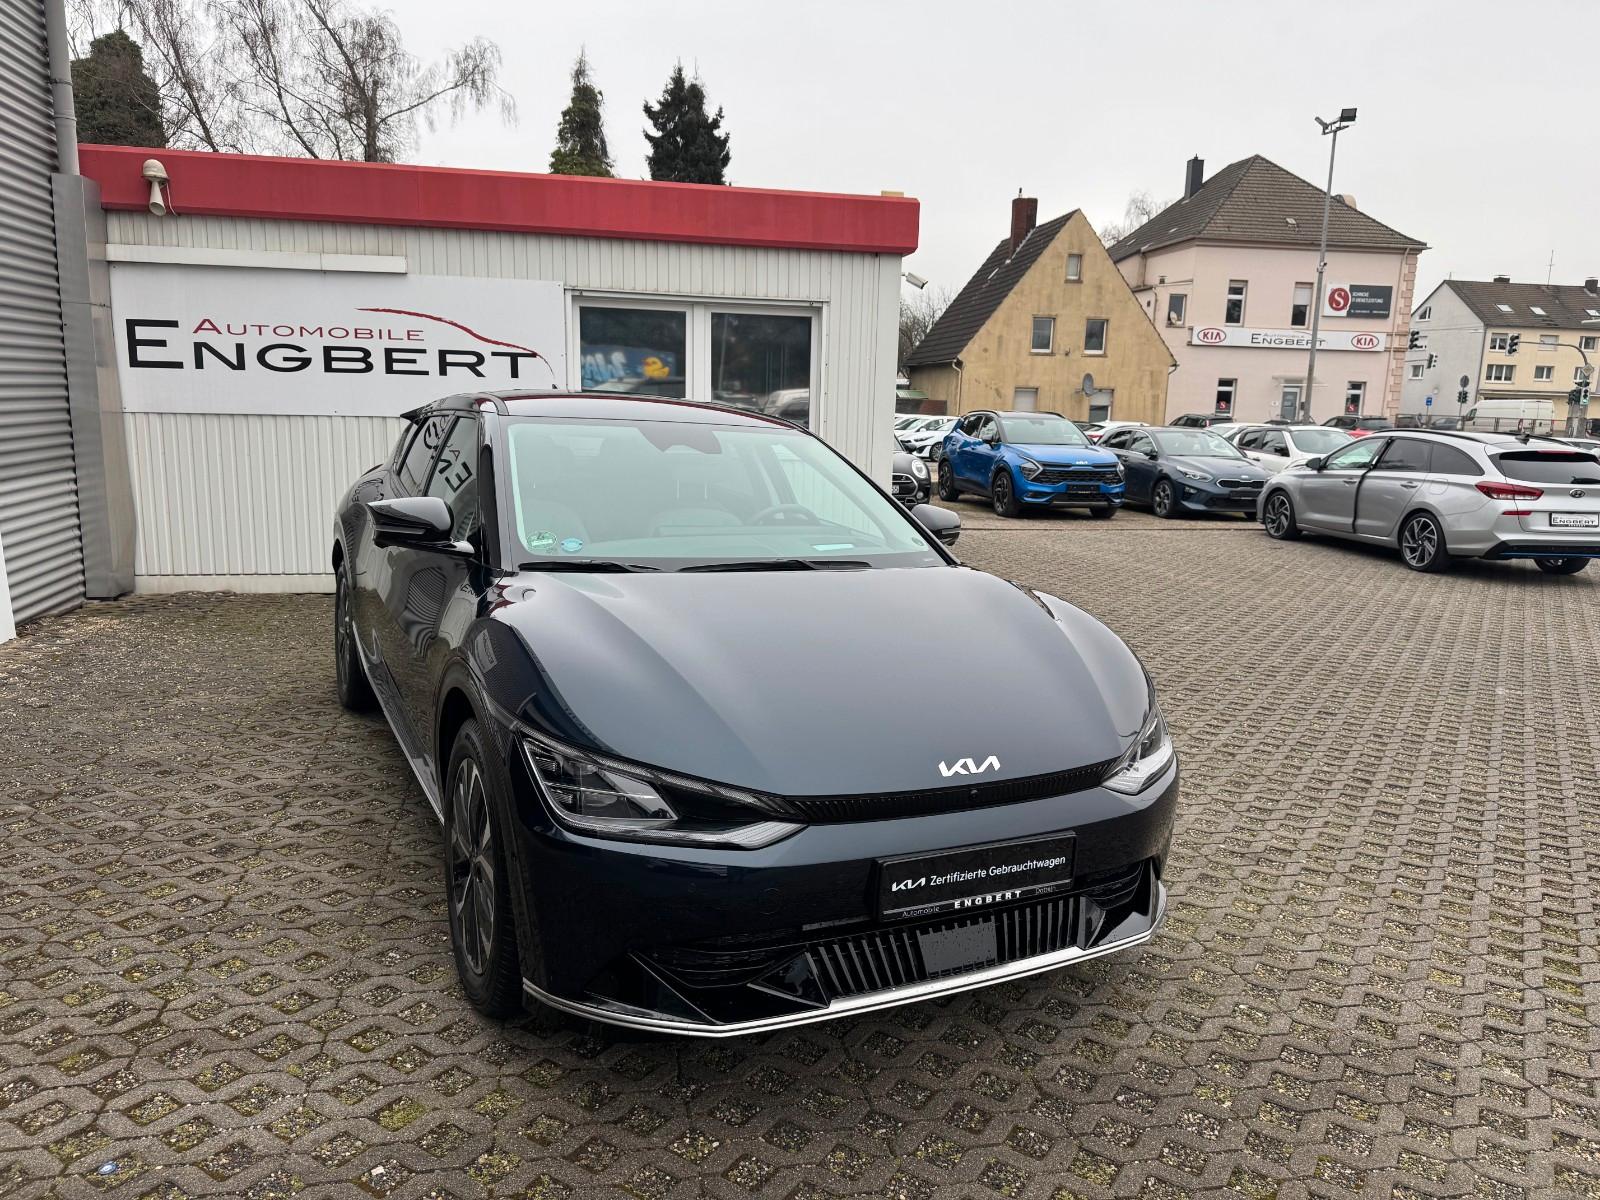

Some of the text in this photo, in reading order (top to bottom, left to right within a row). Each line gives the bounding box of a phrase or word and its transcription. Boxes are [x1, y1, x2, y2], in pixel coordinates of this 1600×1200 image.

[1332, 291, 1345, 308] S
[193, 318, 425, 342] AUTOMOBILE
[1202, 331, 1221, 341] KIA
[125, 318, 538, 379] ENGBERT
[1355, 336, 1375, 347] KIA
[1552, 516, 1595, 525] ENGBERT
[938, 755, 1001, 777] KIA
[891, 856, 1066, 892] KIA Zertifizierte Gebrauchtwagen
[954, 890, 1022, 909] ENGBERT
